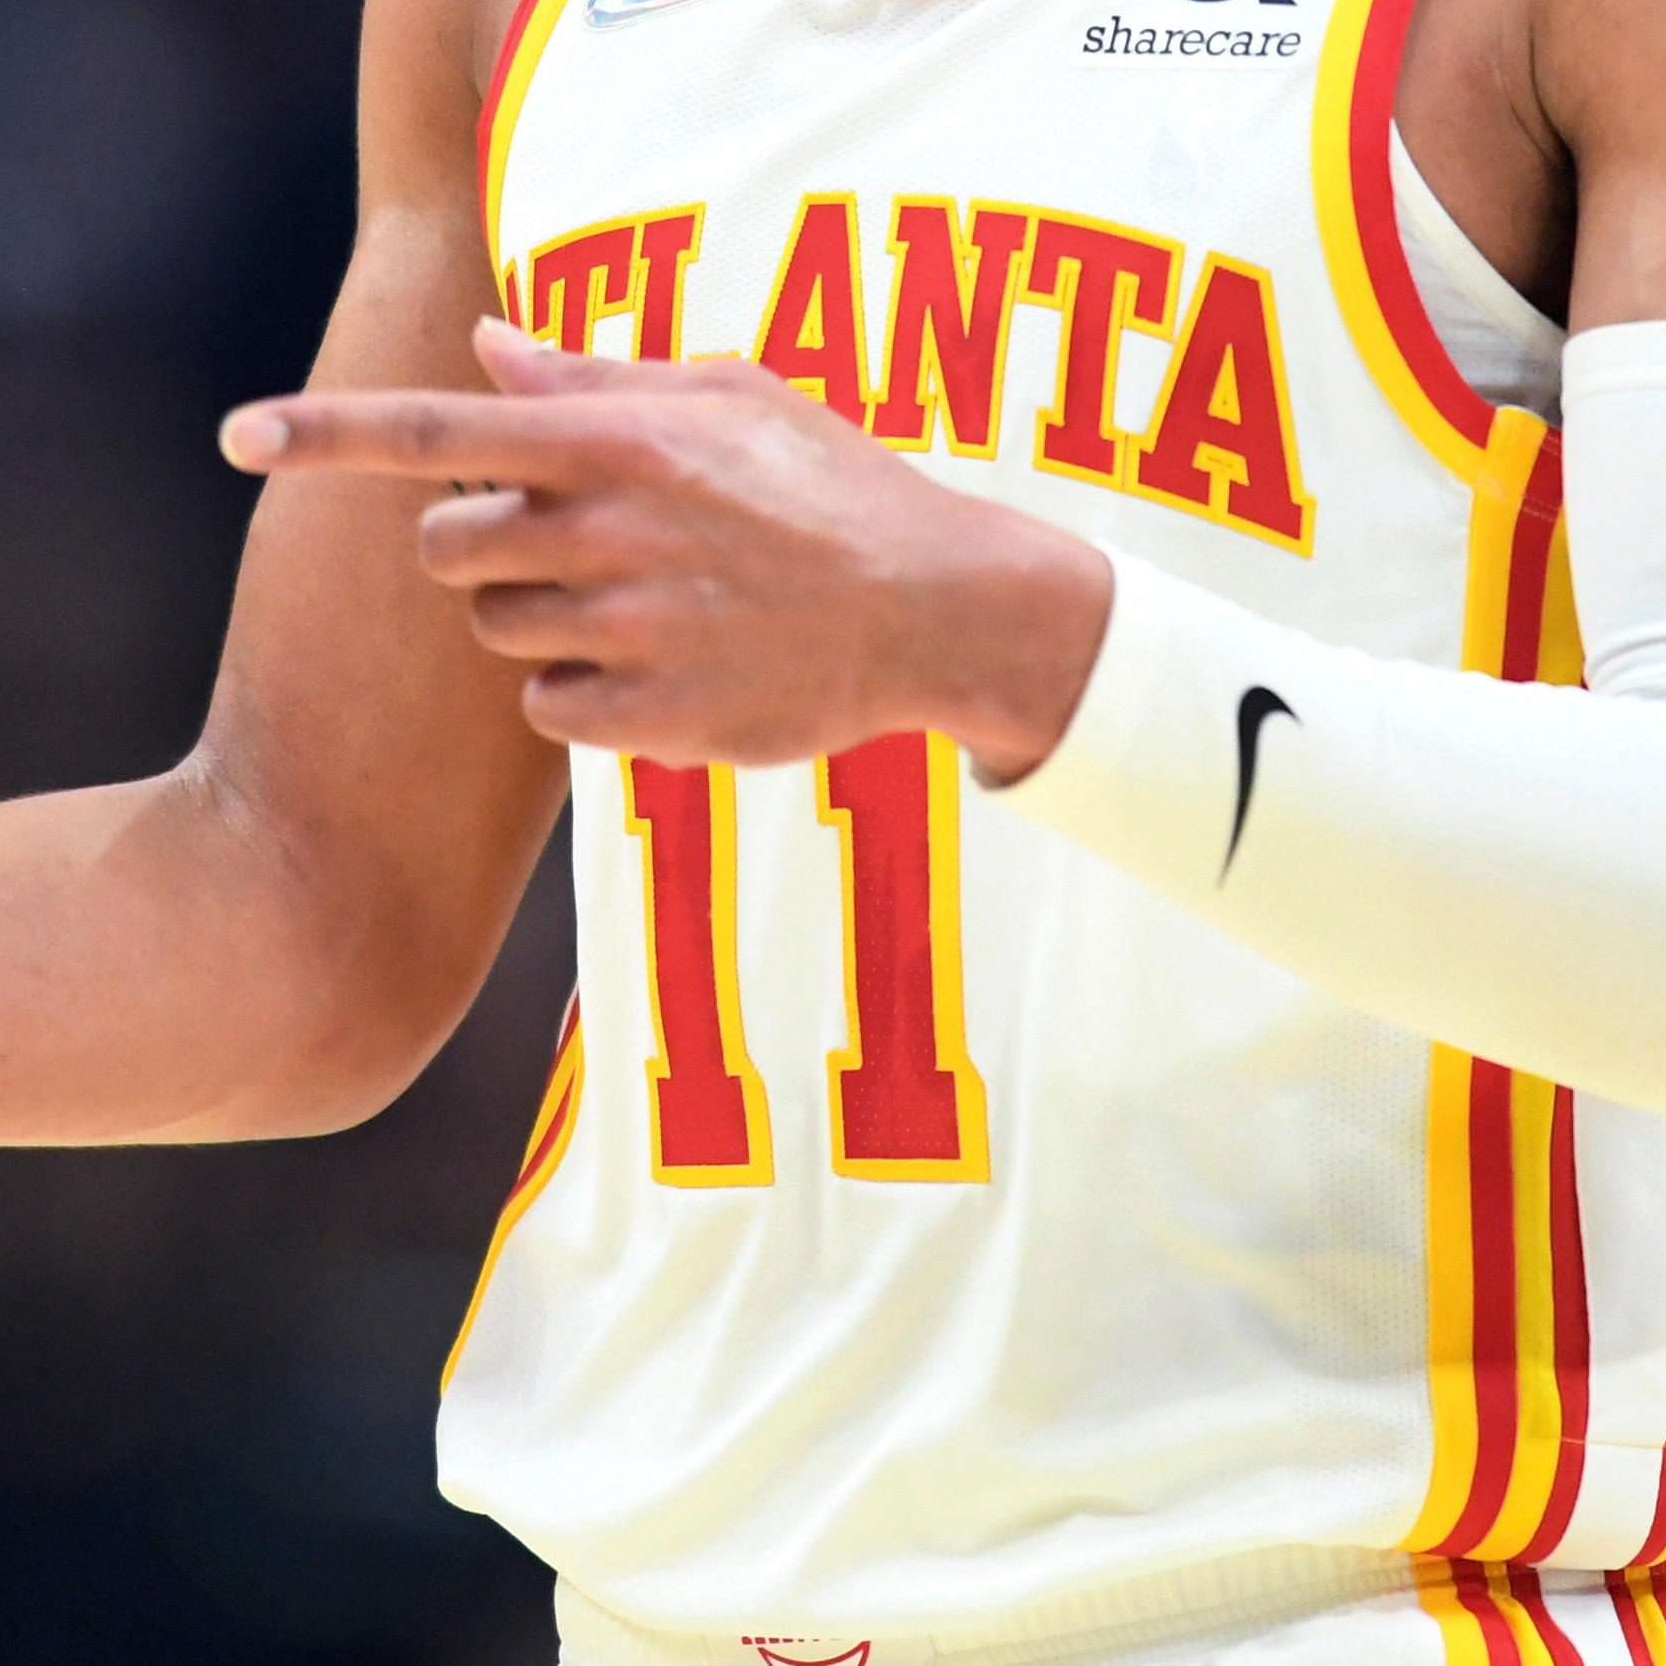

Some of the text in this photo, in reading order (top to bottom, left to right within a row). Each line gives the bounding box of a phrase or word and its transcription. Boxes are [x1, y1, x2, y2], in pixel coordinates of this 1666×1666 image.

[1082, 14, 1302, 58] sharecare
[502, 190, 1316, 560] TLANTA
[617, 728, 991, 1188] 11
